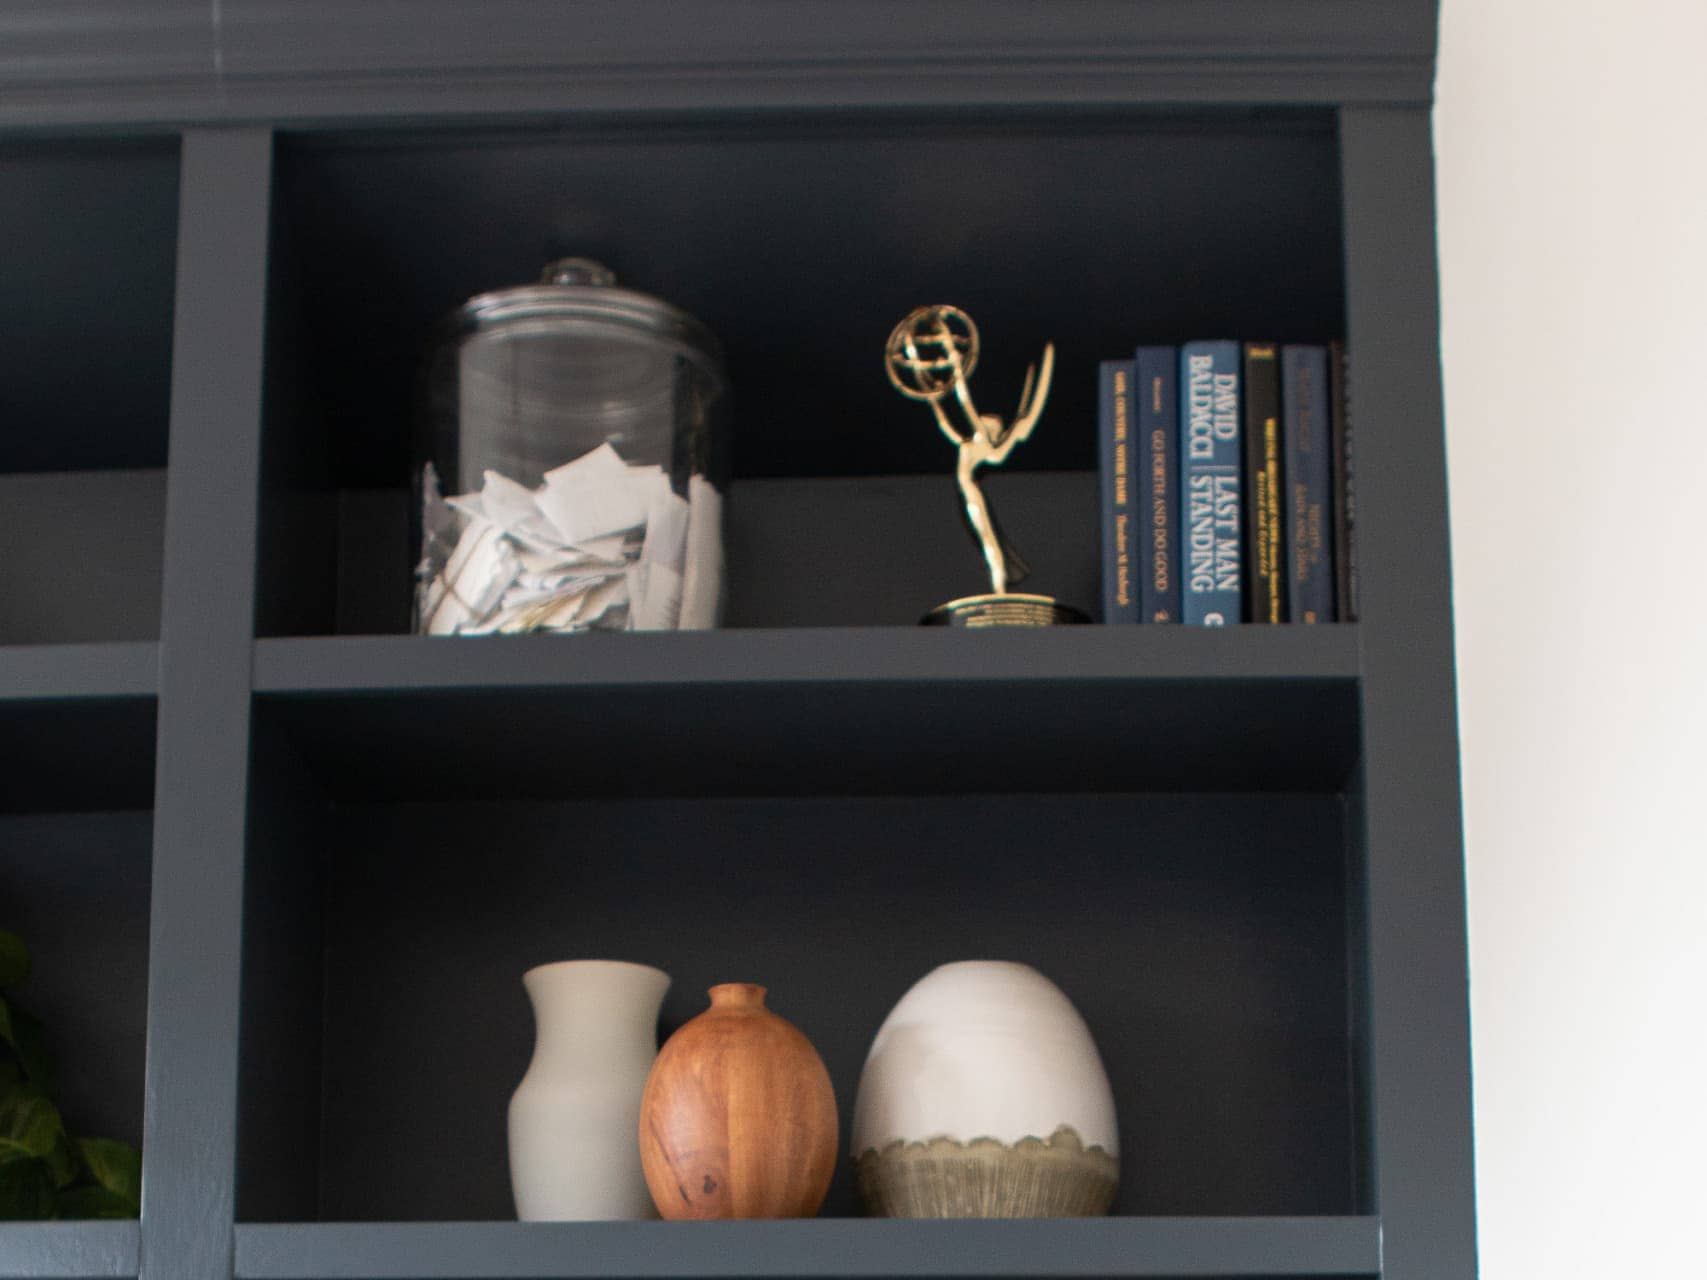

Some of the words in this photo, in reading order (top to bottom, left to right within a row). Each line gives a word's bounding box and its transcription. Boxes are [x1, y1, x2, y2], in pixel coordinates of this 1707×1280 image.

[1189, 355, 1214, 460] BALDACCI
[1214, 373, 1237, 441] DAVID
[1152, 429, 1165, 450] GO
[1153, 452, 1166, 495] FORTH
[1154, 496, 1166, 526] AND
[1215, 475, 1239, 531] LAST
[1154, 528, 1167, 550] DO
[1189, 475, 1214, 593] STANDING
[1154, 551, 1168, 592] GOOD
[1215, 537, 1239, 592] MAN
